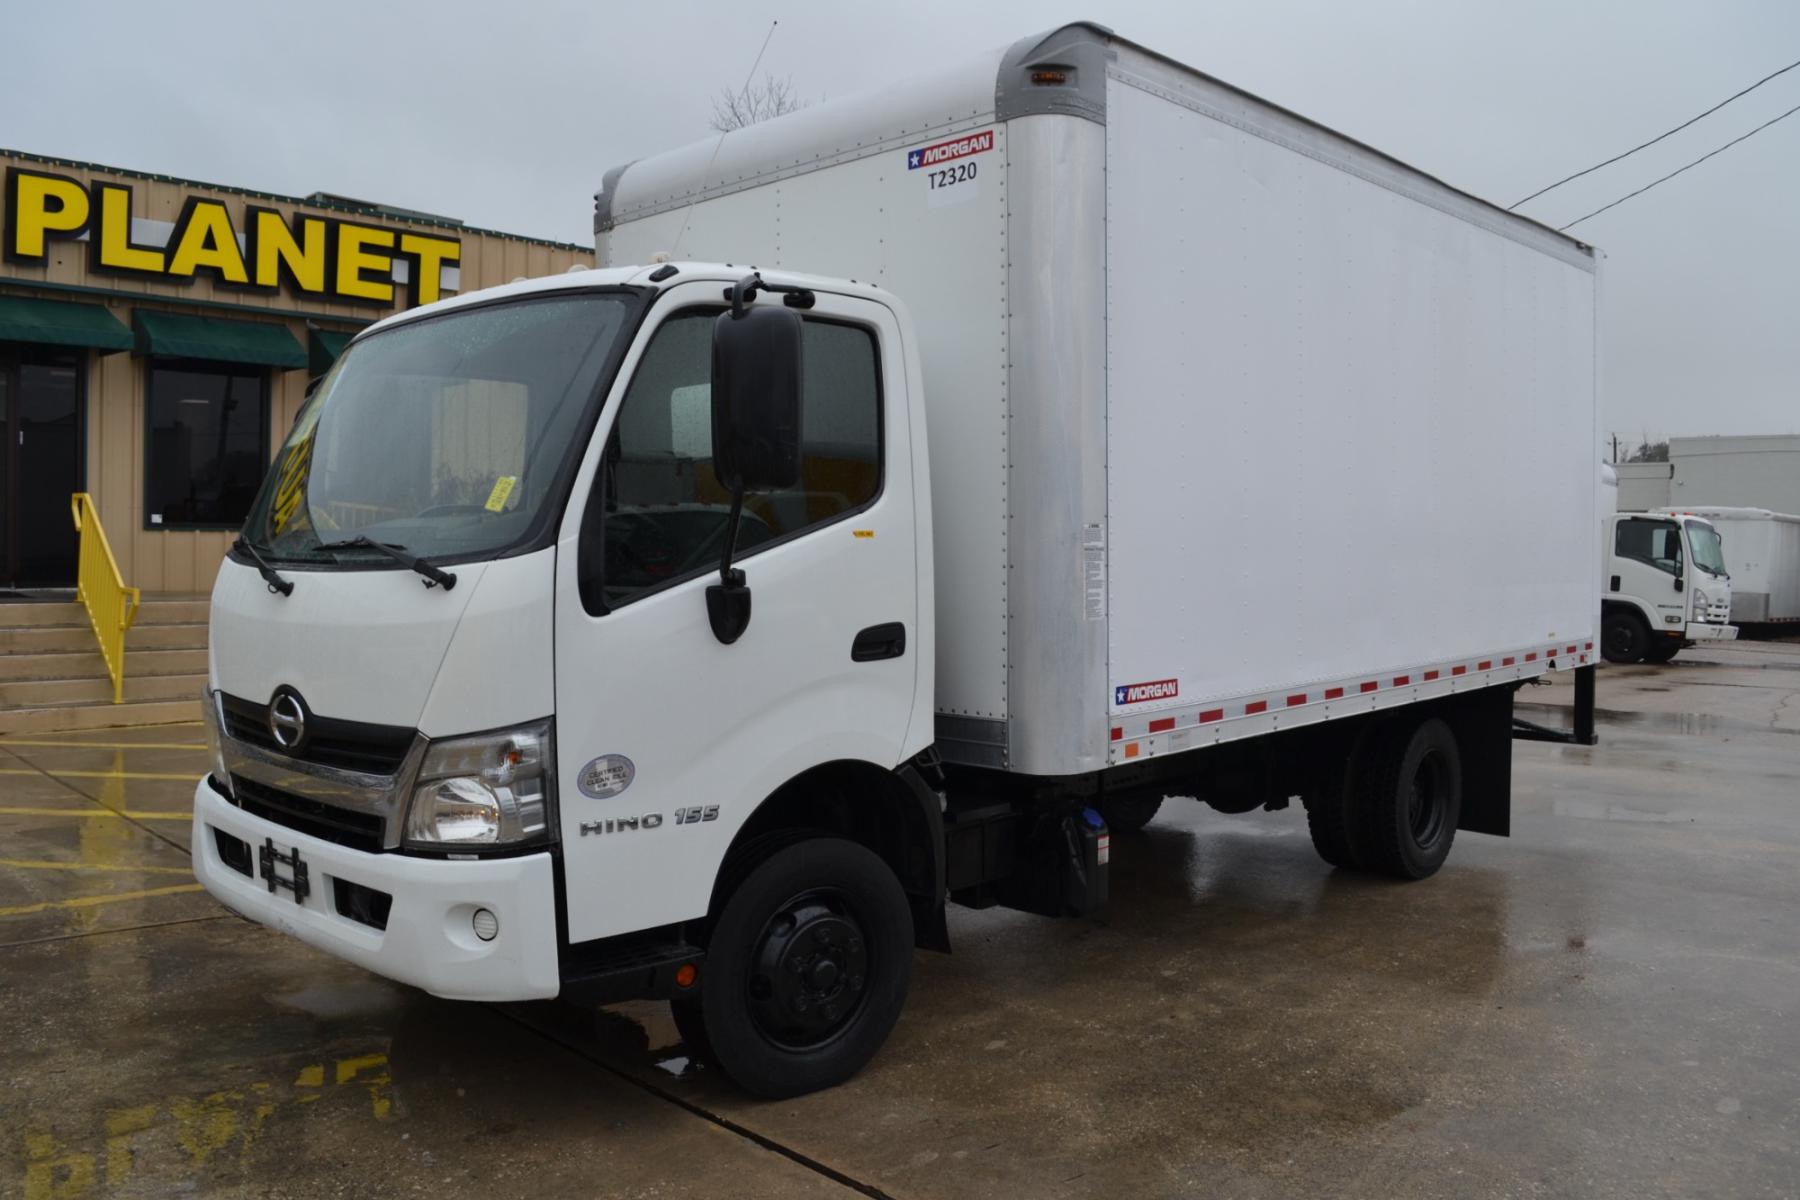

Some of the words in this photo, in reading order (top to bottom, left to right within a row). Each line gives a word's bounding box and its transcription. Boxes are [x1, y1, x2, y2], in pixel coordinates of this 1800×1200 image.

[922, 133, 990, 164] MORGAN
[928, 162, 977, 189] T2320
[13, 171, 462, 306] PLANET
[1127, 682, 1176, 702] MORGAN
[580, 812, 663, 837] HINO
[675, 804, 720, 825] 155
